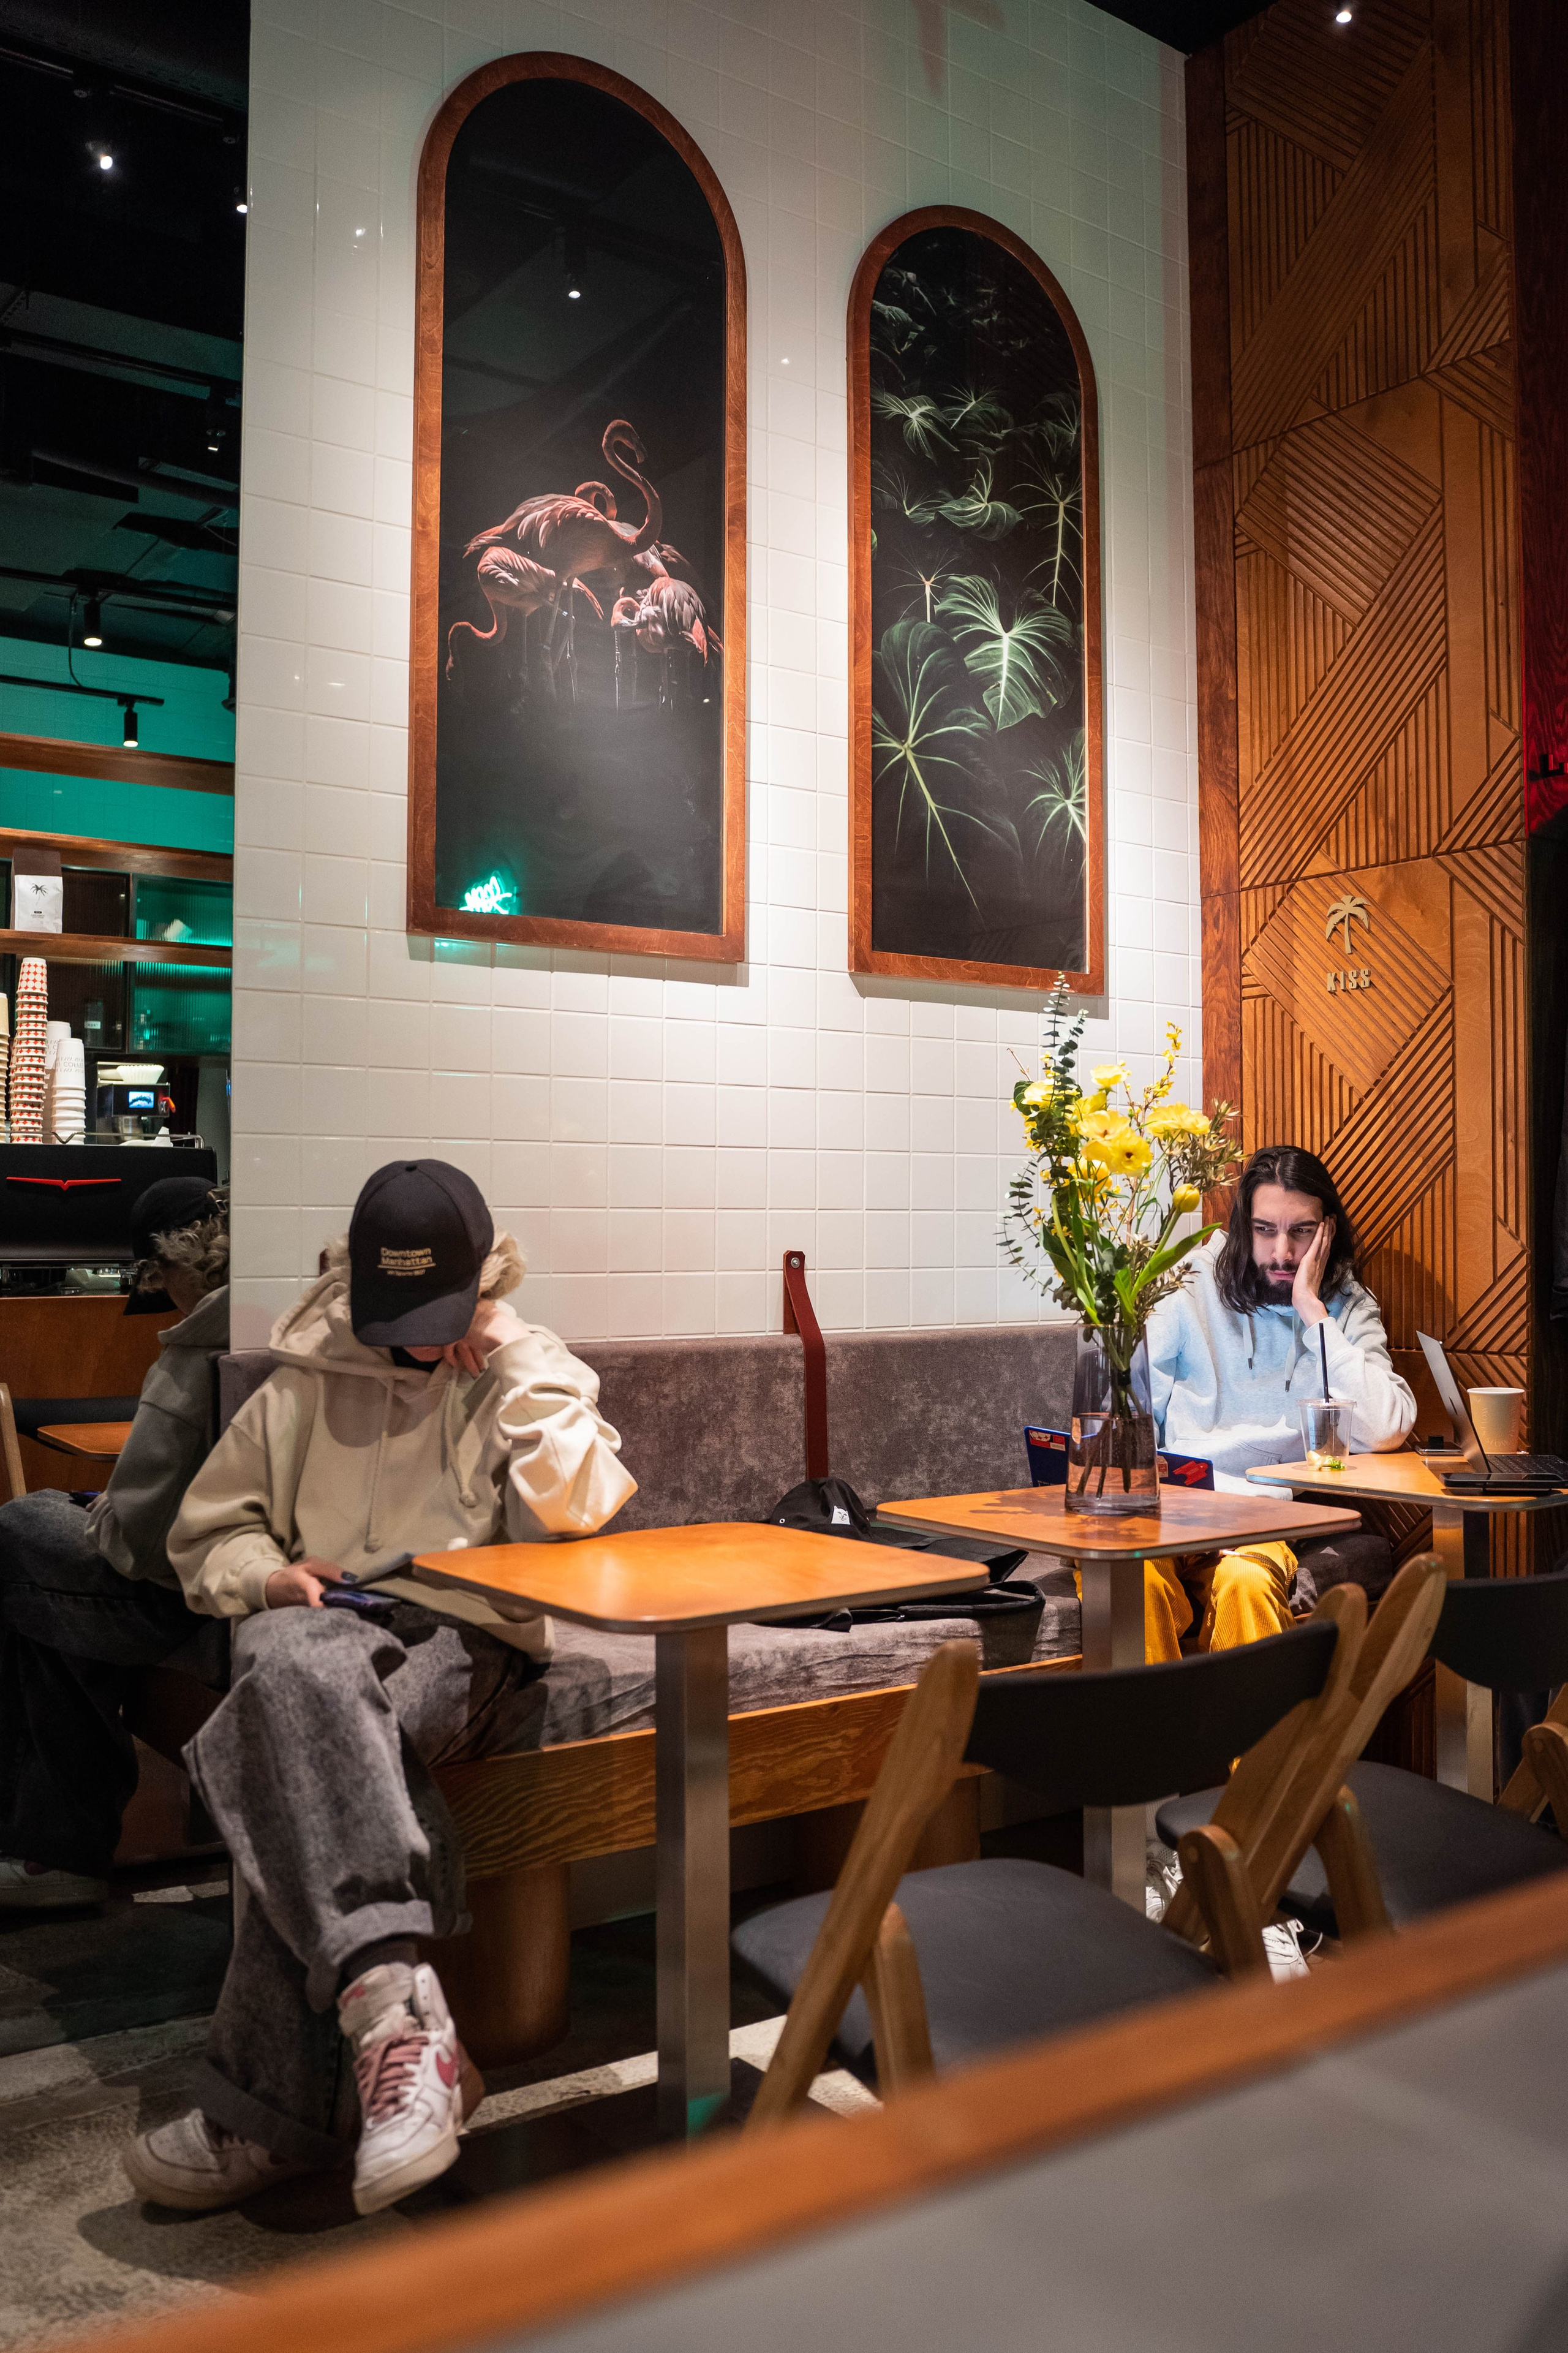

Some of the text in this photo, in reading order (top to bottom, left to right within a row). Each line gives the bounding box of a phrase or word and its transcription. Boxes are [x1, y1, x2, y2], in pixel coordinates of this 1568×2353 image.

[1327, 969, 1371, 992] KISS
[380, 1247, 431, 1258] Downtown
[381, 1256, 432, 1266] Manhattan
